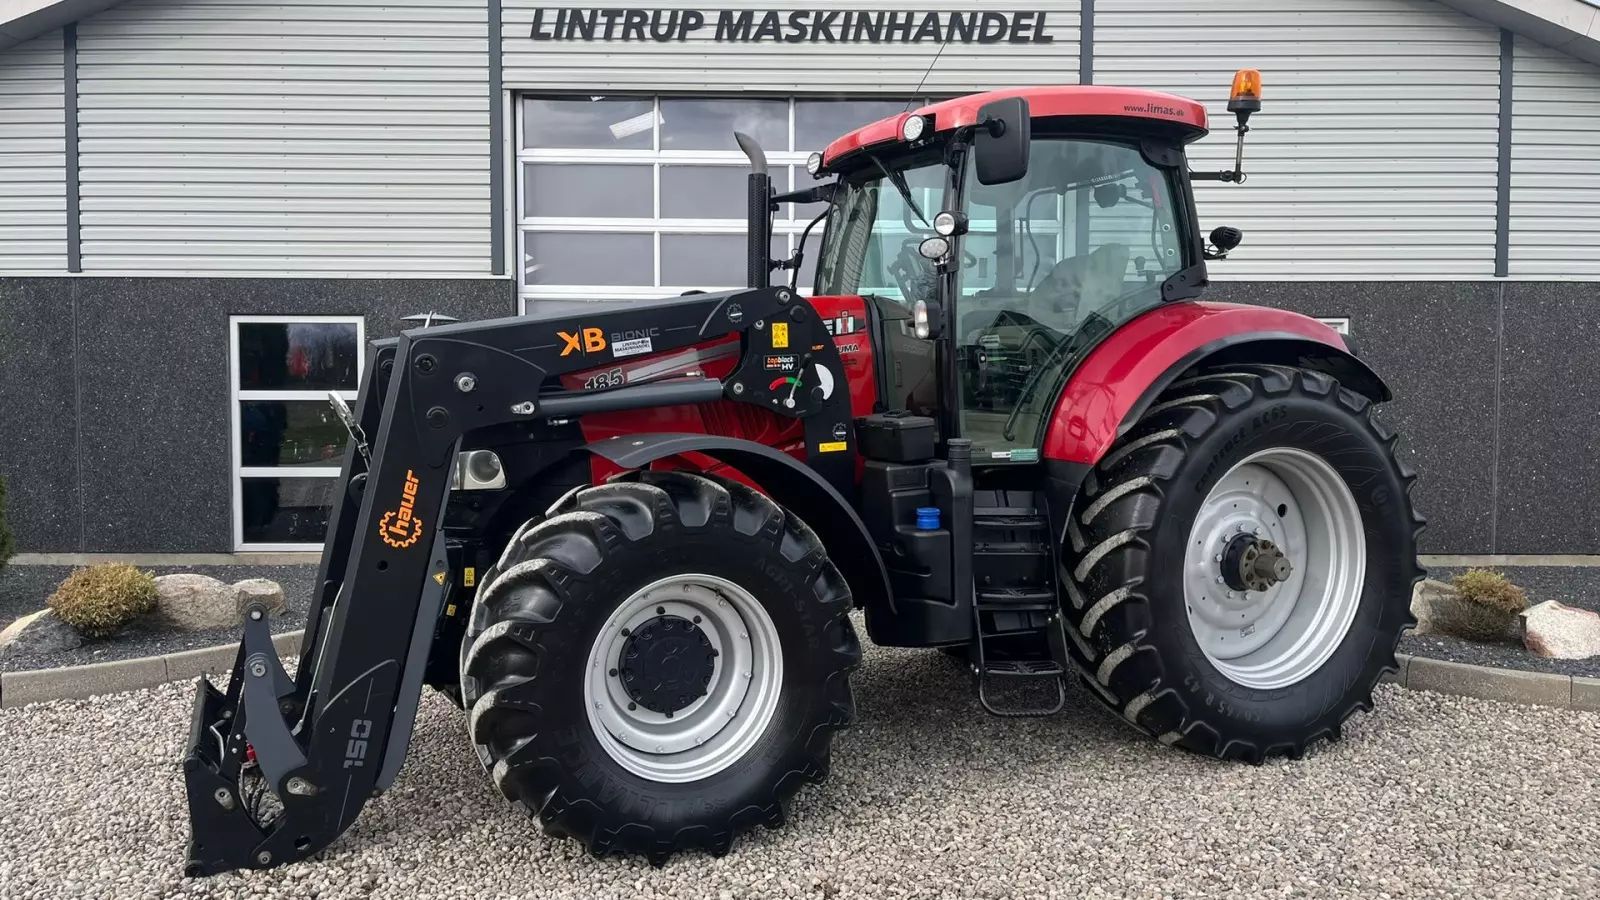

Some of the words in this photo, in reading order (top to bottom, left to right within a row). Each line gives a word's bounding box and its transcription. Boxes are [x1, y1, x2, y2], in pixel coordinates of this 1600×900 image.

[530, 9, 704, 42] LINTRUP
[714, 9, 1053, 43] MASKINHANDEL
[1123, 103, 1184, 116] www.limas.dk
[611, 327, 660, 342] BIONIC
[584, 367, 625, 390] 185
[781, 363, 794, 371] HV
[388, 469, 419, 537] hauer
[343, 718, 372, 769] 150
